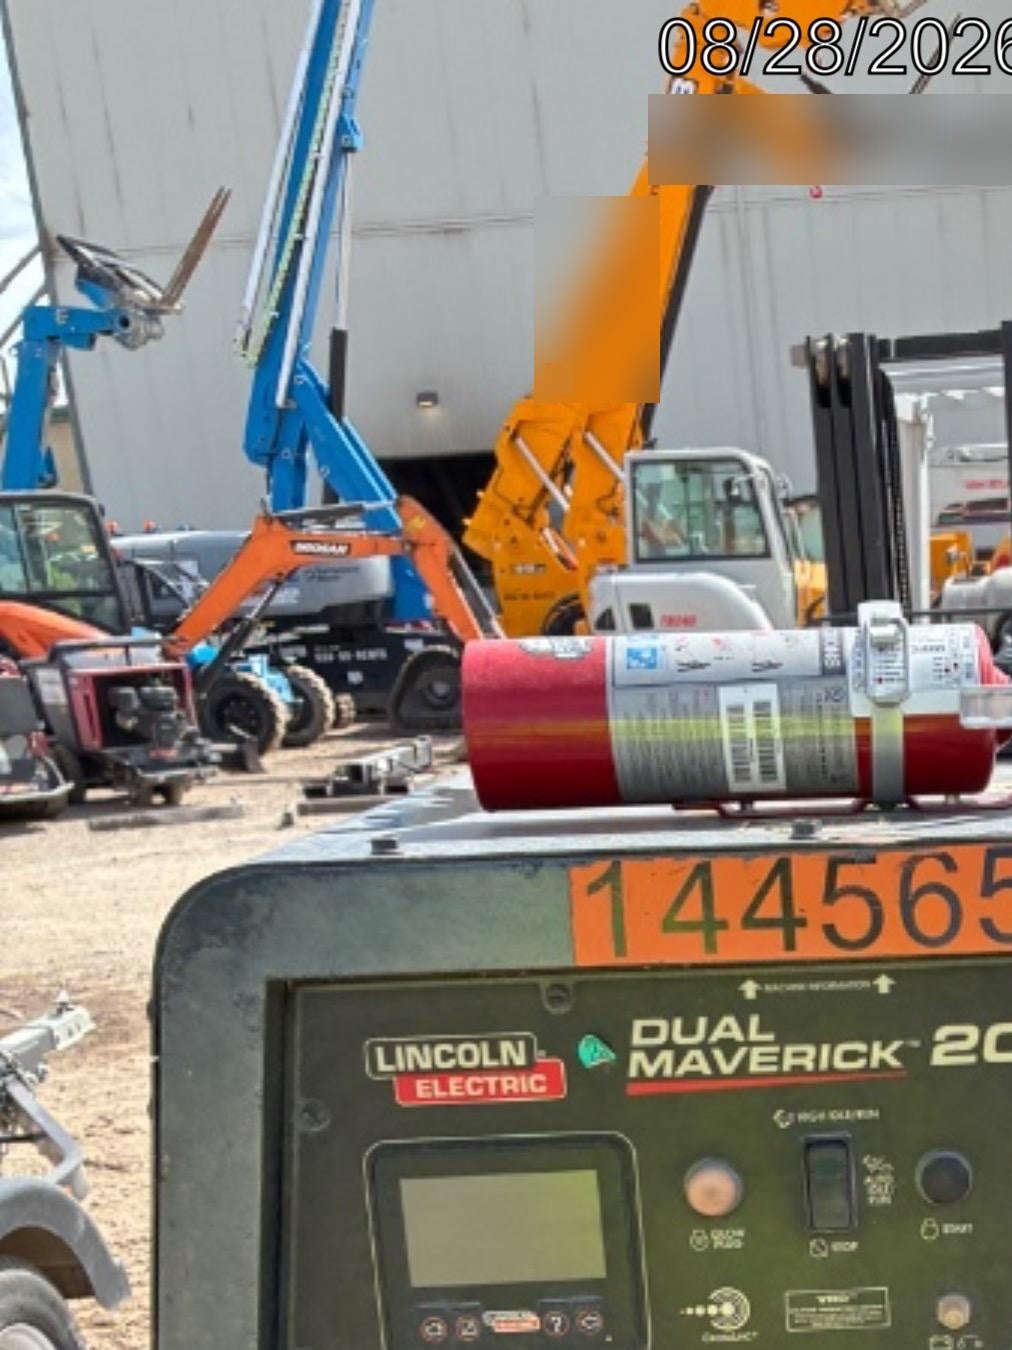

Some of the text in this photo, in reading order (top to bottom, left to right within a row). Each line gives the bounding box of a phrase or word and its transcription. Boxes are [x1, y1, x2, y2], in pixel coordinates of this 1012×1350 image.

[631, 1015, 776, 1045] DUAL
[375, 1039, 527, 1073] LINCOLN
[627, 1040, 906, 1078] MAVERICK
[415, 1074, 547, 1098] ELECTRIC
